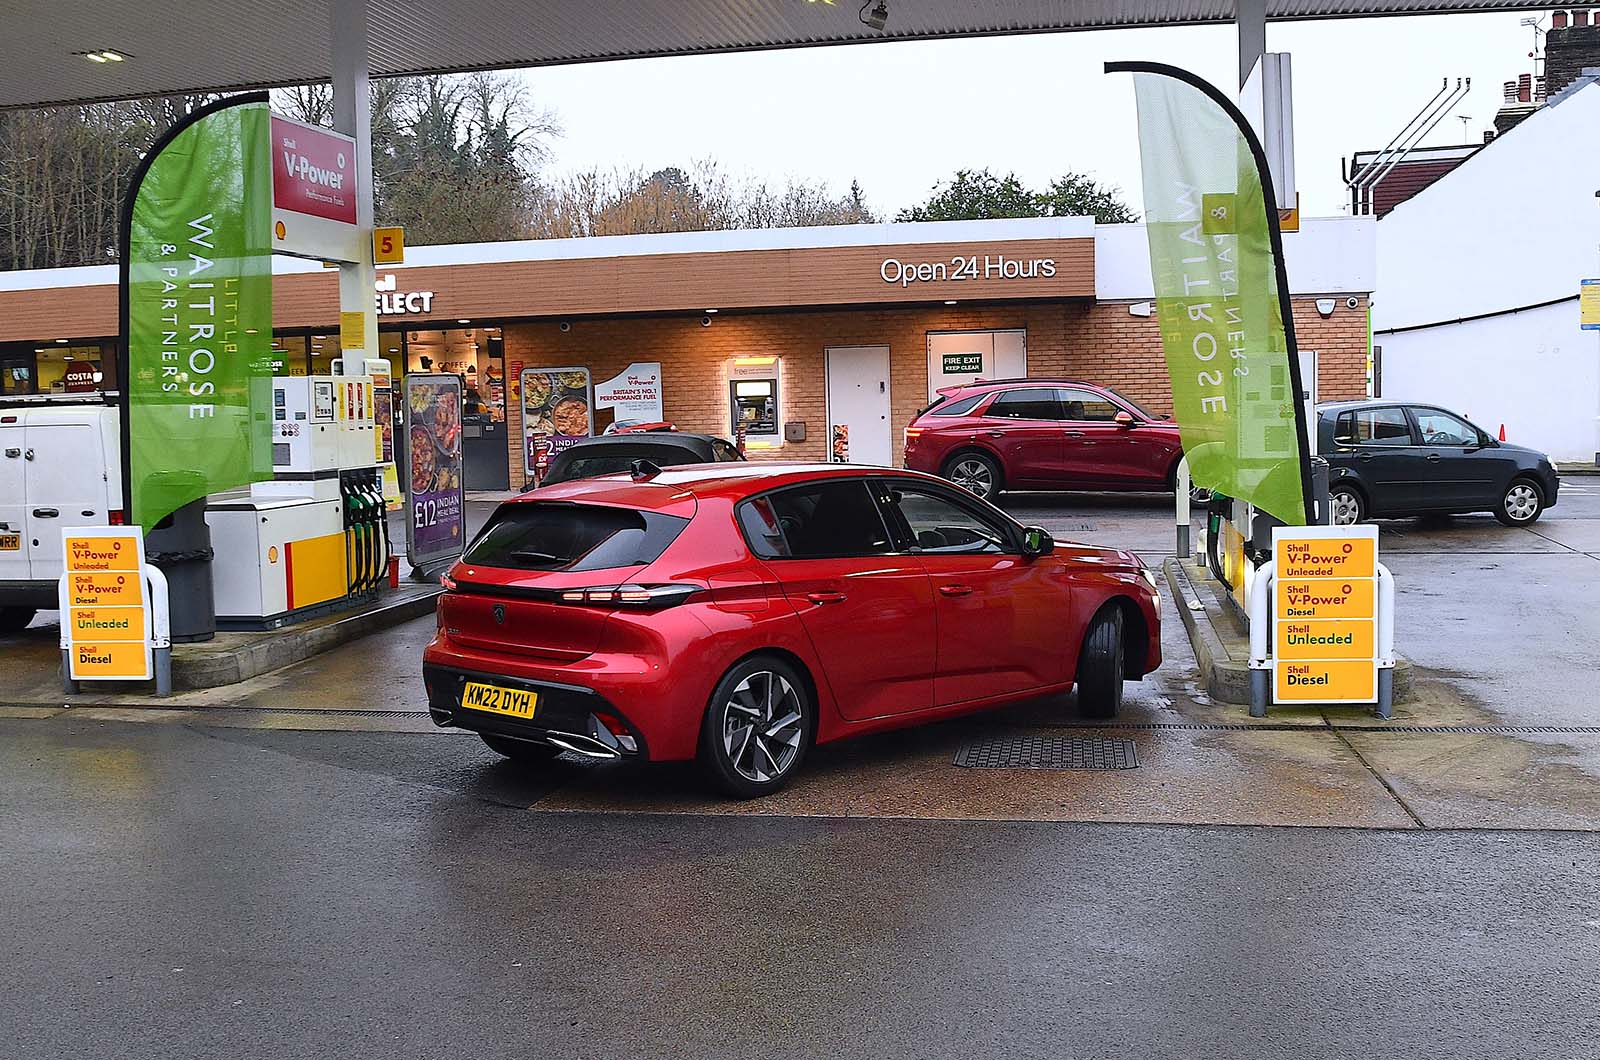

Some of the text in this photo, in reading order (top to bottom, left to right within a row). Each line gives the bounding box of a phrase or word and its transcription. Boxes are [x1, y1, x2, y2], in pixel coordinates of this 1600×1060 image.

[284, 151, 344, 190] V-Power
[381, 236, 393, 254] 5
[880, 255, 1056, 287] Open 24 Hours
[375, 292, 434, 314] ELECT
[161, 244, 178, 392] & PARTNERS
[187, 214, 214, 418] WAITROSE
[437, 496, 459, 508] INDIAN
[415, 500, 436, 528] £12
[1287, 544, 1309, 552] Shell
[73, 550, 118, 559] V-Power
[1288, 554, 1348, 564] V-Power
[1287, 567, 1333, 576] Unleaded
[76, 585, 122, 593] V-Power
[1287, 585, 1309, 593] Shell
[1288, 595, 1347, 604] V-Power
[78, 618, 128, 628] Unleaded
[1288, 633, 1352, 644] Unleaded
[80, 654, 112, 663] Diesel
[1288, 673, 1328, 685] Diesel
[467, 685, 530, 713] KM22 DYH
